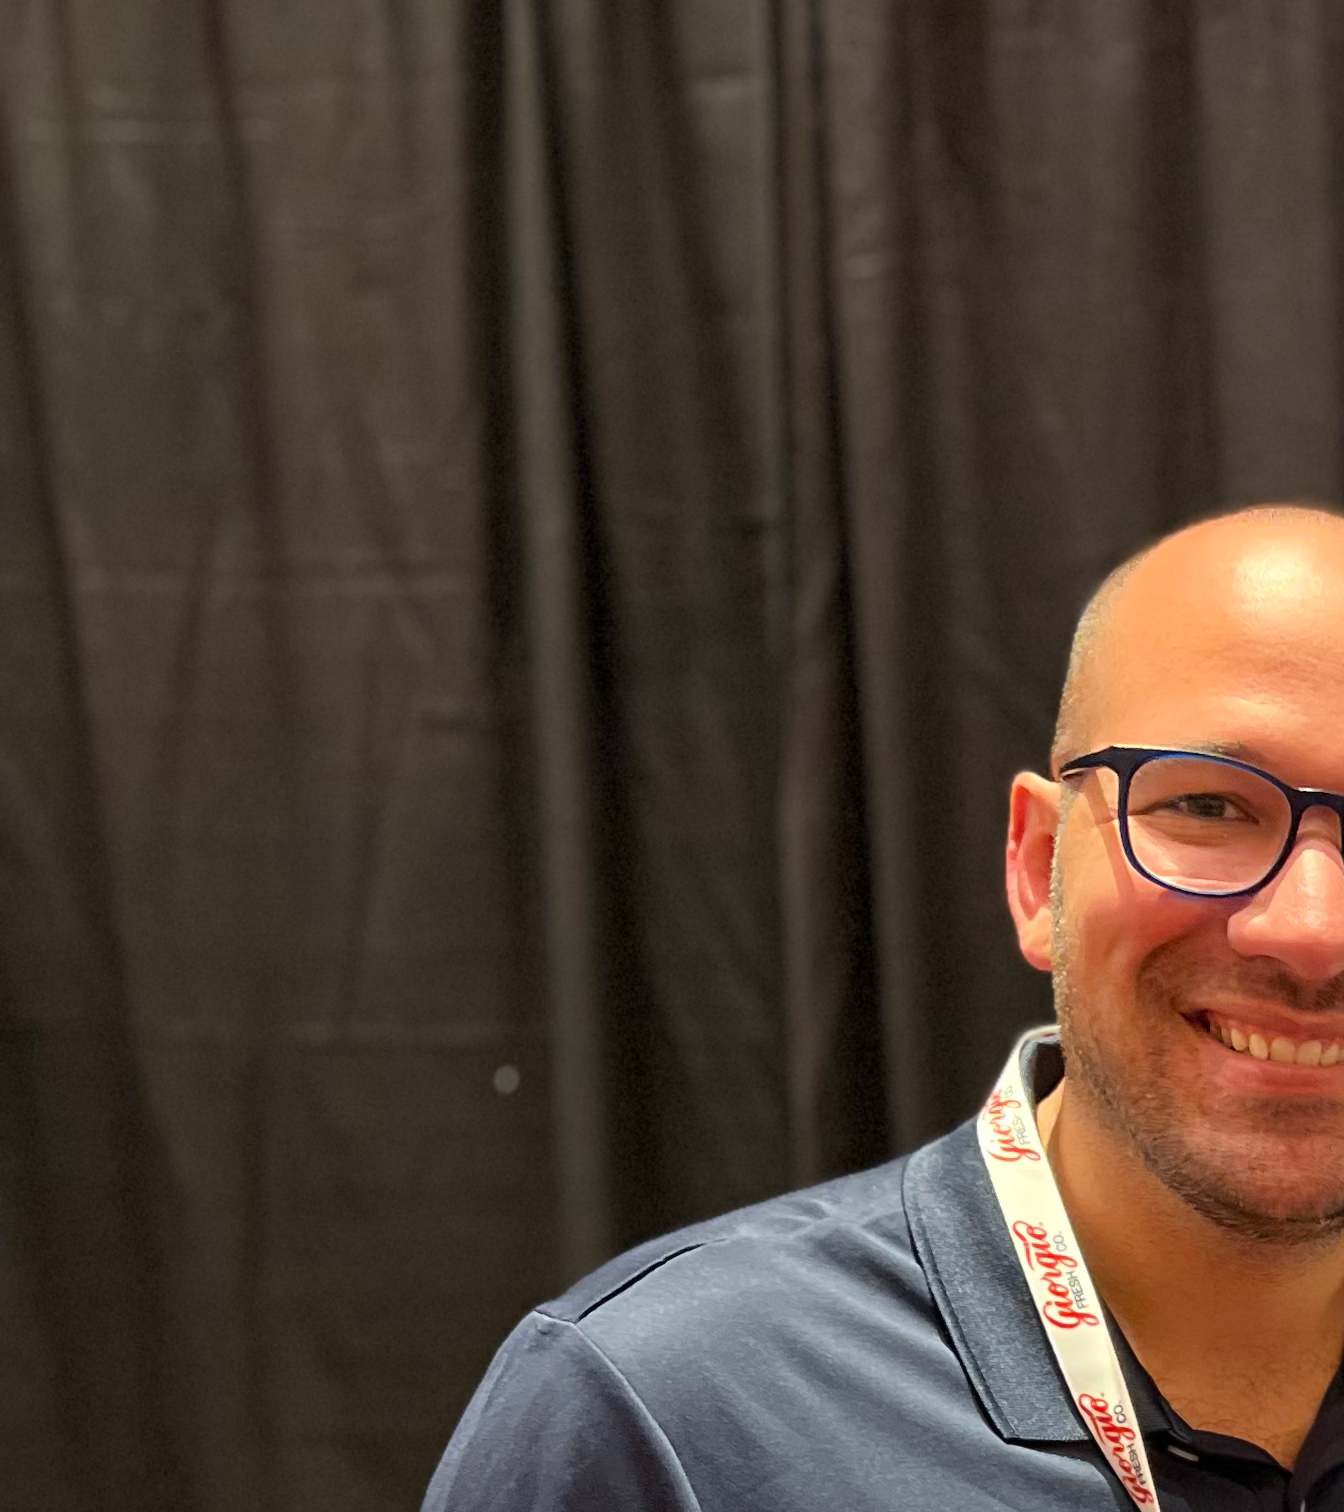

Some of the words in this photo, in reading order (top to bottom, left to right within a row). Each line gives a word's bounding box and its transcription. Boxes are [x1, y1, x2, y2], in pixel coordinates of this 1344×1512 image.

[1012, 1220, 1100, 1330] Giorgio
[1066, 1270, 1092, 1310] FRESH
[1127, 1443, 1146, 1486] FRESH
